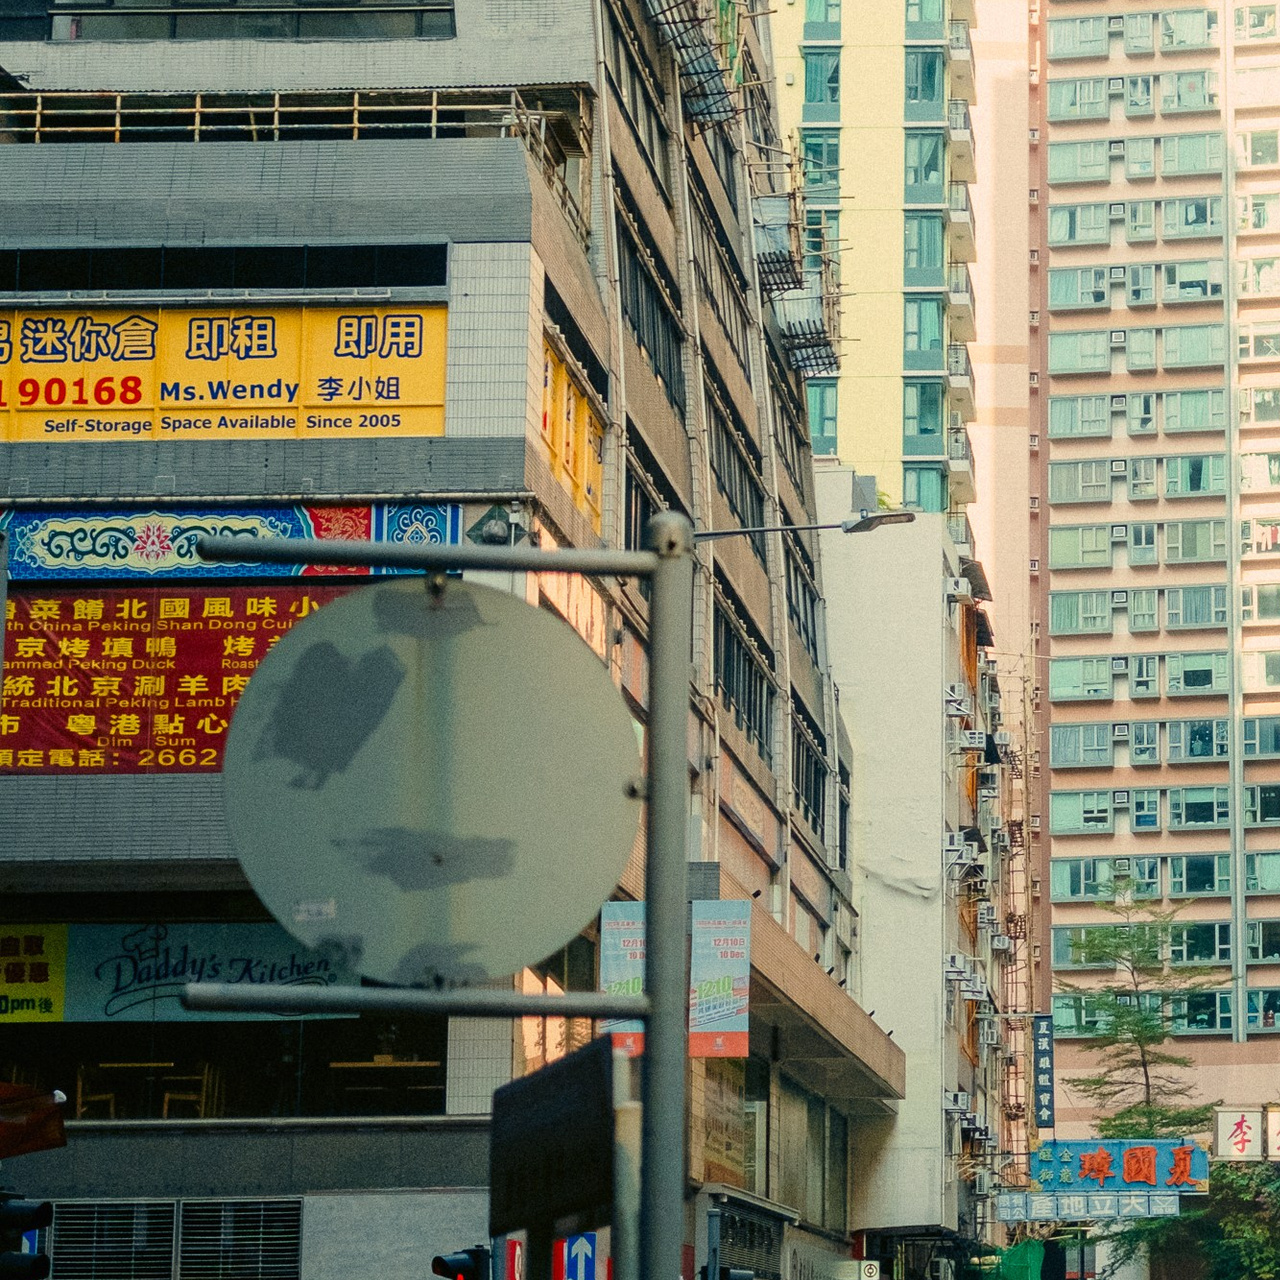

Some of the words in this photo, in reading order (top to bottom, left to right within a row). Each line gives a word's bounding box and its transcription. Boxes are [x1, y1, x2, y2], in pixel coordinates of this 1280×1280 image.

[186, 315, 277, 361] 即租
[334, 314, 423, 358] 即用
[160, 379, 300, 402] Ms.Wendy
[317, 376, 400, 401] 李小姐
[44, 418, 153, 434] Self-Storage
[160, 416, 212, 432] Space
[217, 415, 297, 428] Available
[306, 415, 352, 428] Since
[359, 414, 401, 428] 2005
[29, 621, 82, 631] China
[88, 621, 150, 632] Peking
[156, 620, 203, 630] Shan
[208, 620, 257, 632] Dong
[68, 659, 126, 672] Peking
[132, 659, 176, 669] Duck
[2, 697, 101, 708] Traditional
[106, 697, 169, 710] Peking
[175, 696, 225, 707] Lamb
[97, 736, 132, 747] Dim
[155, 736, 196, 747] Sum
[137, 749, 217, 767] 2662
[95, 945, 221, 994] Daddy's
